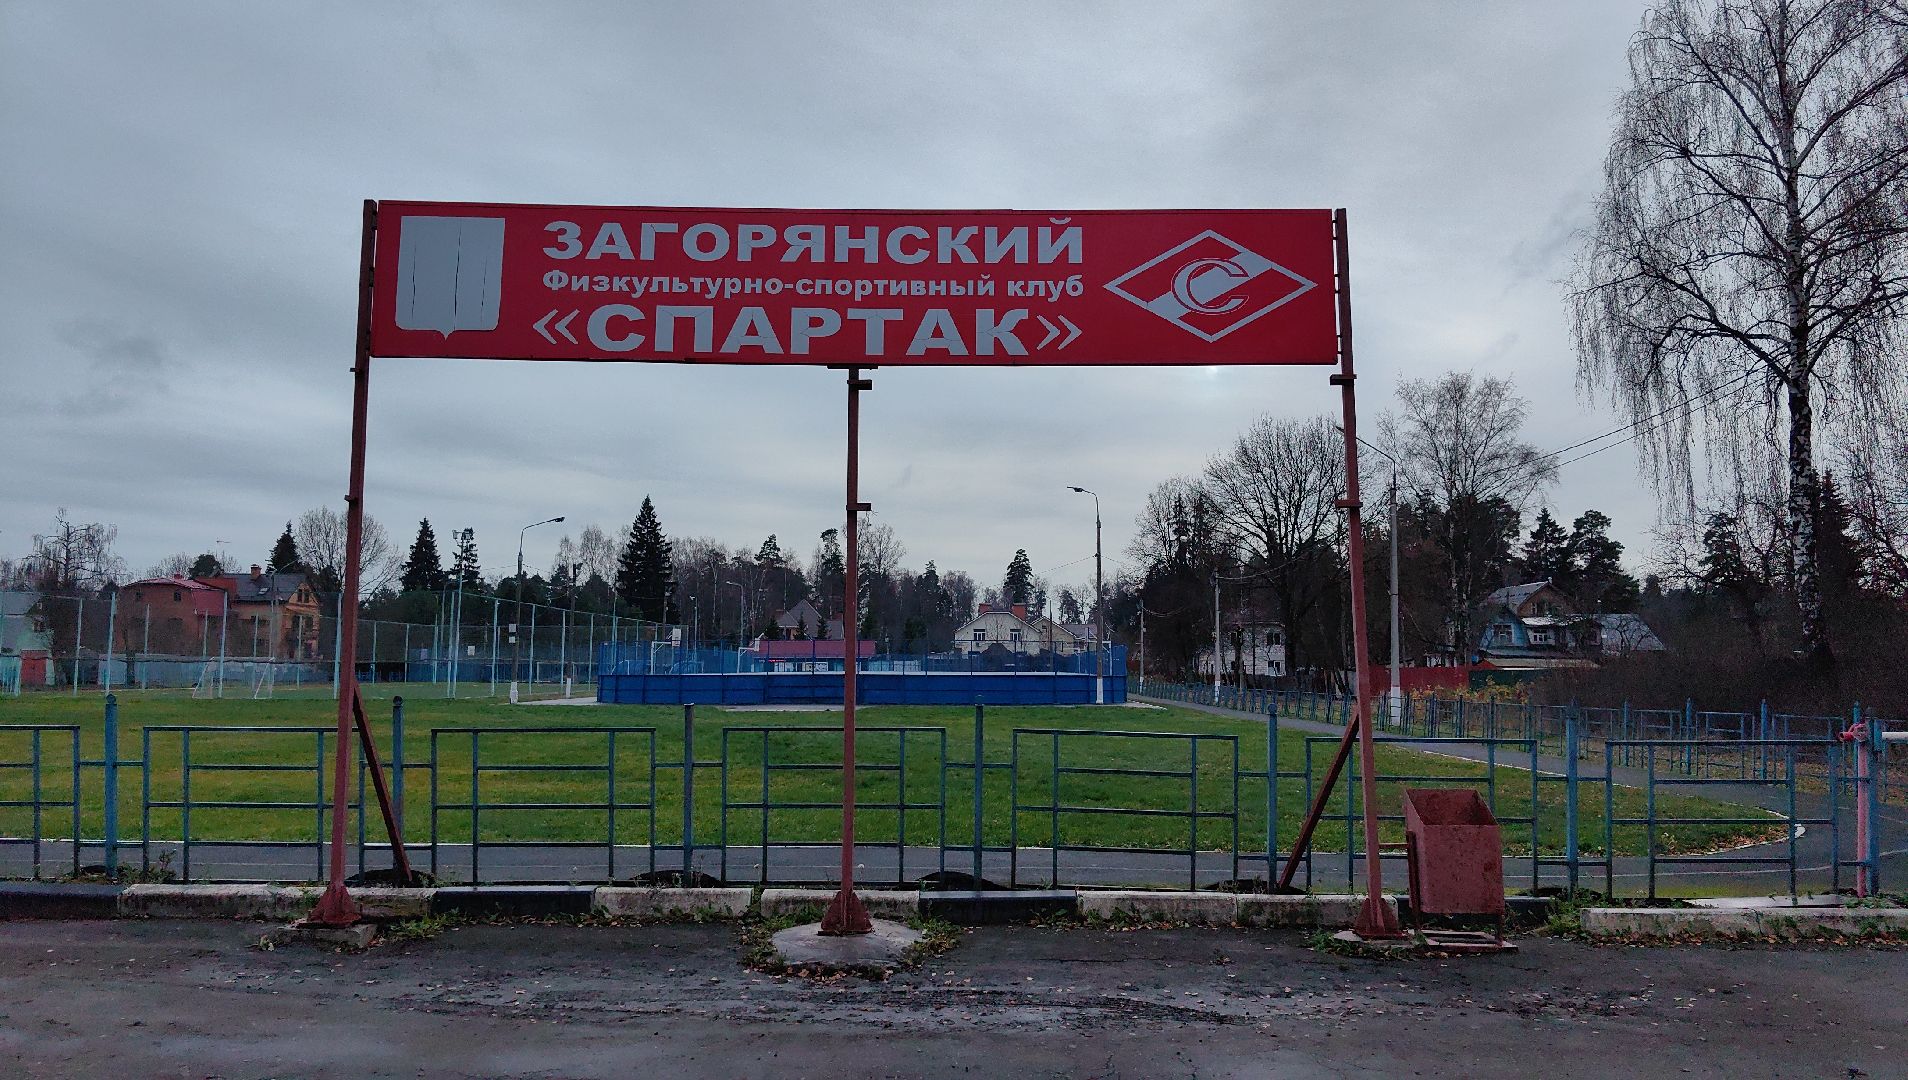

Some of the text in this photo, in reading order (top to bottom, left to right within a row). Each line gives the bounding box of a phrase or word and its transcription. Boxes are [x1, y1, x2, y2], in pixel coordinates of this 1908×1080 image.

[542, 217, 1083, 264] ЗАГОРЯНСКИЙ
[542, 269, 1084, 303] Физкультурно-спортивный клуб
[532, 303, 1084, 356] «СПАРТАК»
